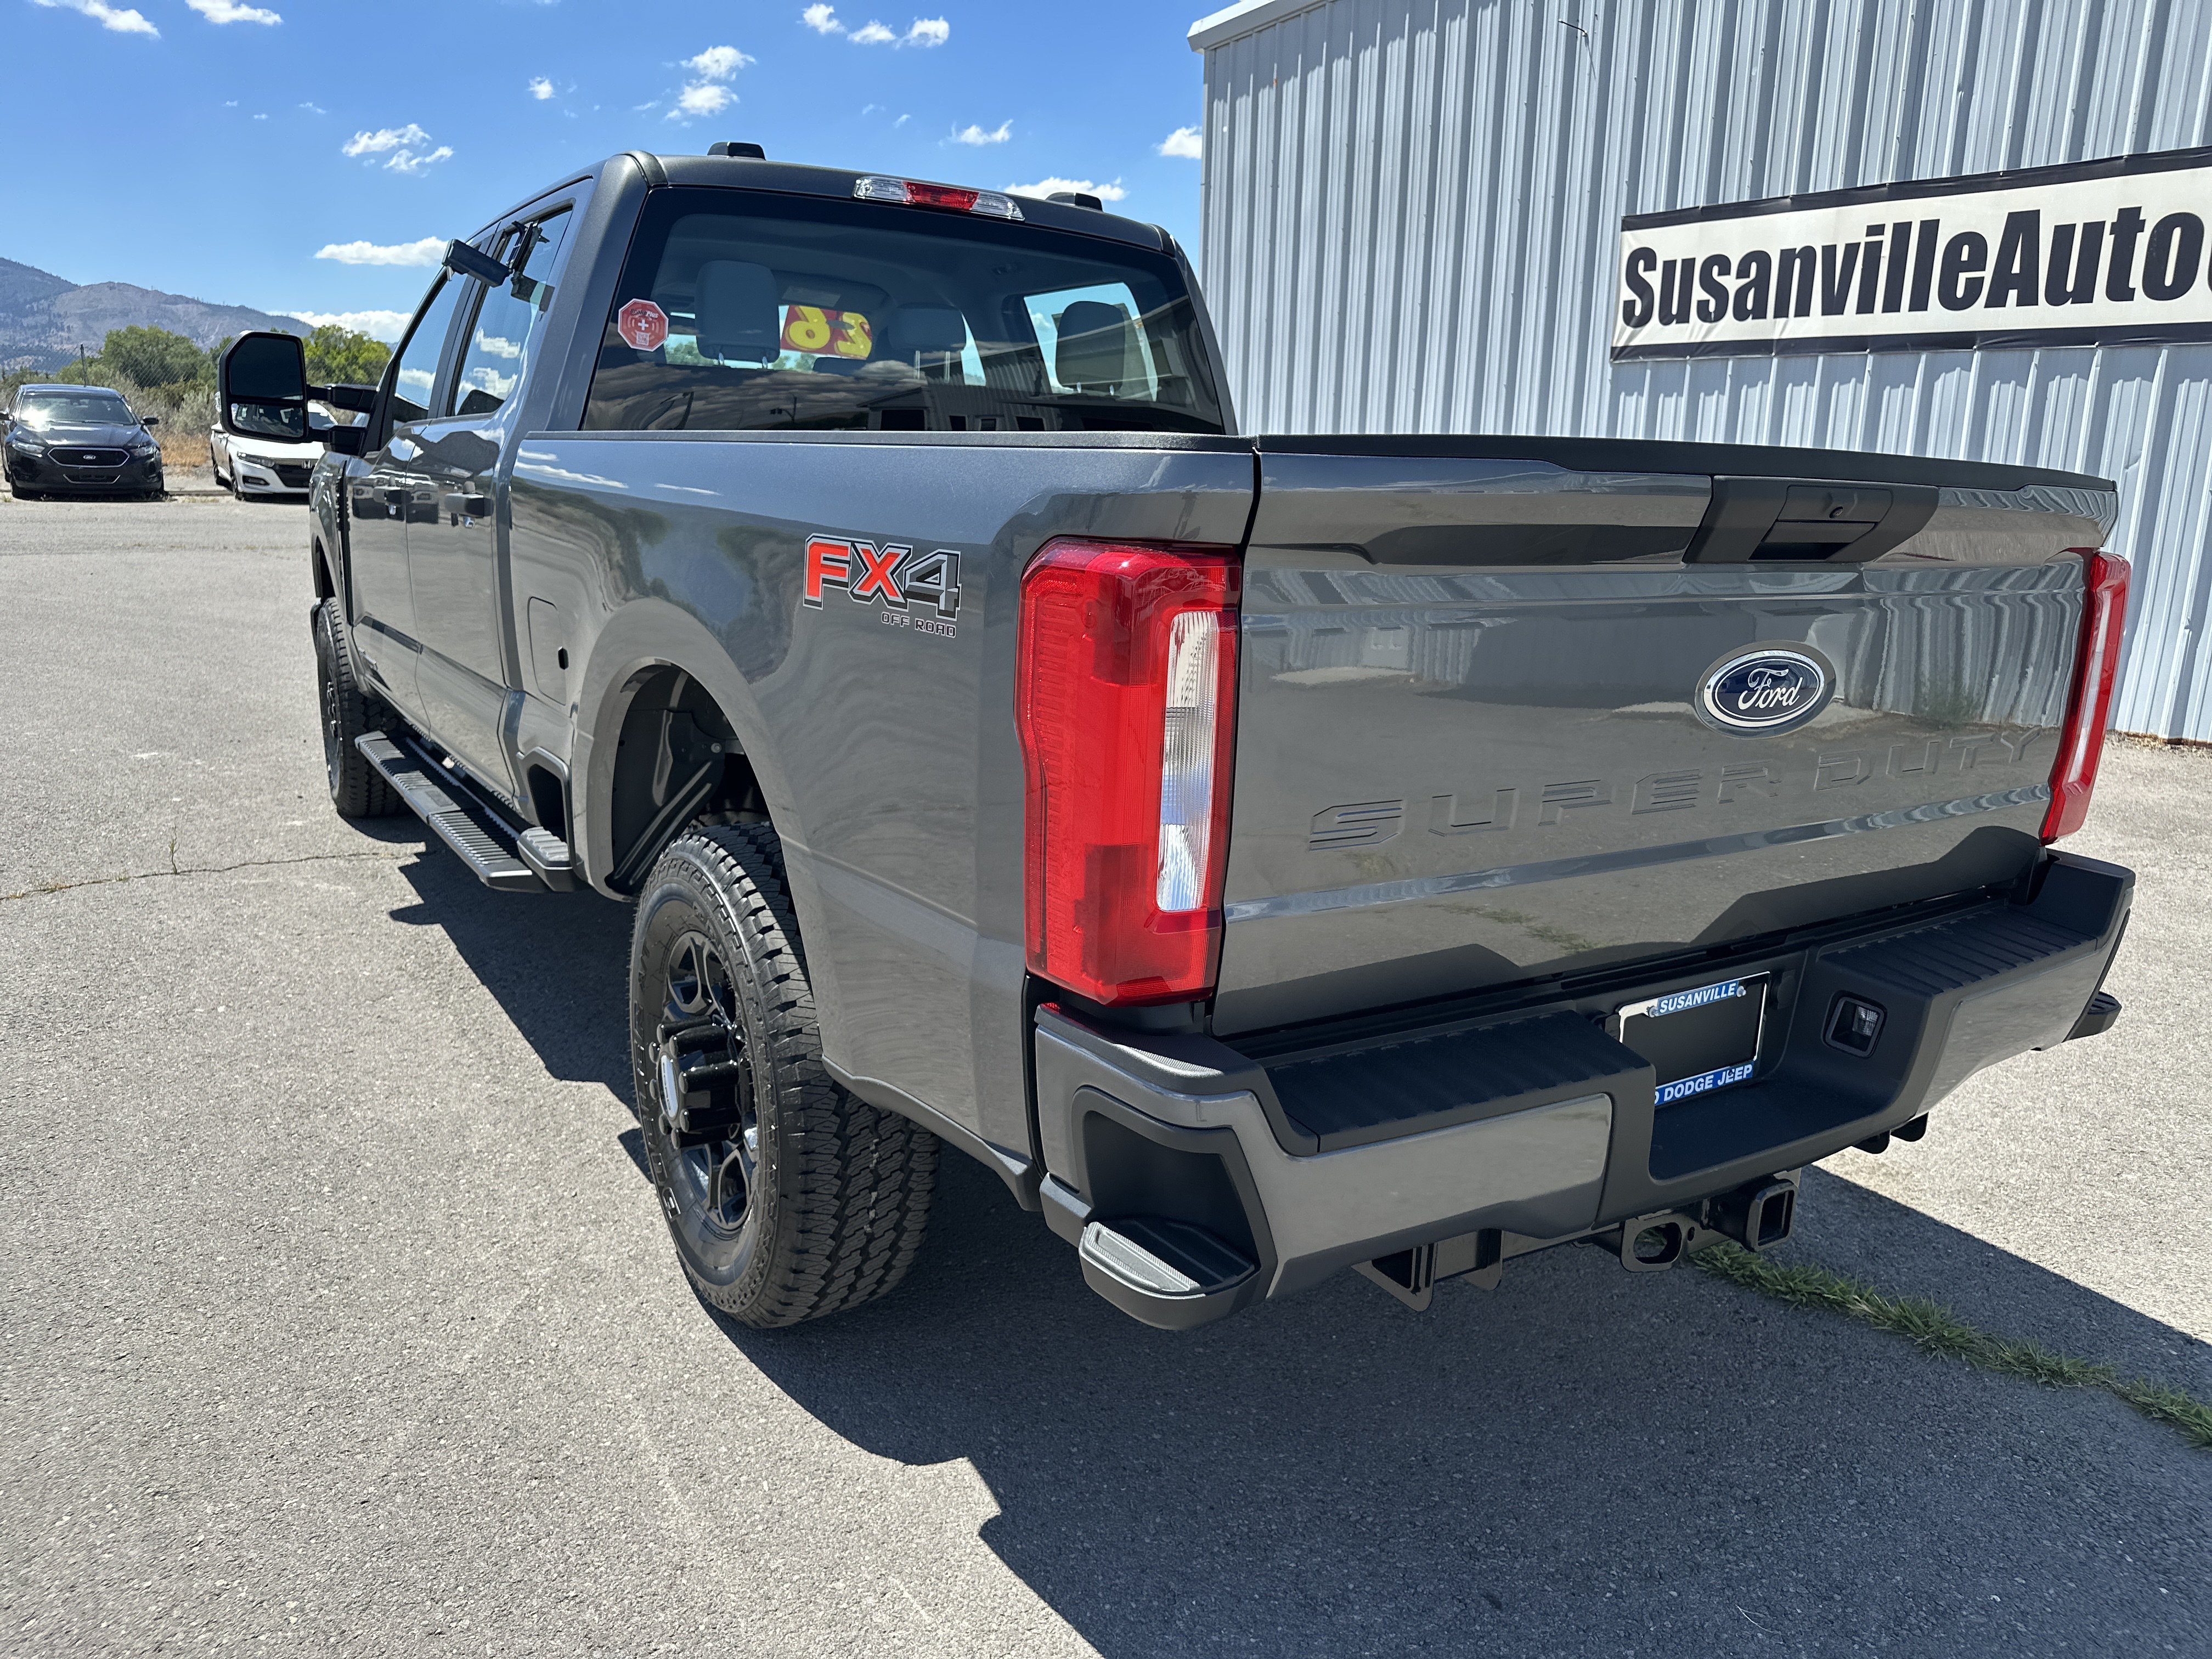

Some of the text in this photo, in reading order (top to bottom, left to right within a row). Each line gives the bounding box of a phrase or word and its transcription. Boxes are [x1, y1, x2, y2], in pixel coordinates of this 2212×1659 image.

[1622, 205, 2212, 329] SusanvilleAuto
[803, 533, 961, 621] FX4
[881, 612, 956, 638] OFF ROAD
[1737, 667, 1803, 710] Ford
[1308, 725, 2042, 852] SUPER DUTY
[1659, 983, 1737, 1014] SUSANVILLE
[1663, 1074, 1714, 1102] DODGE
[1717, 1063, 1753, 1086] JEEP
